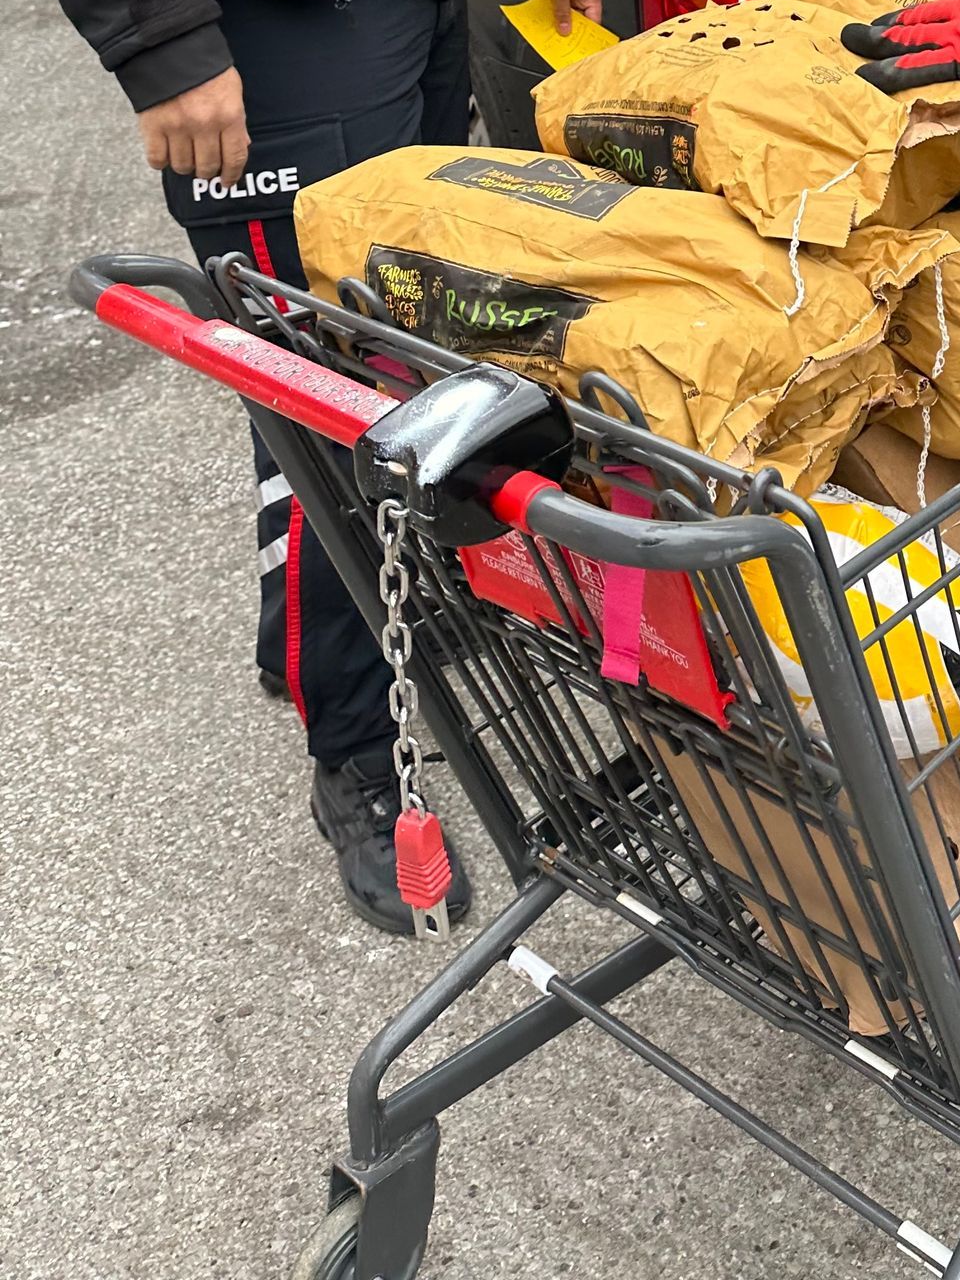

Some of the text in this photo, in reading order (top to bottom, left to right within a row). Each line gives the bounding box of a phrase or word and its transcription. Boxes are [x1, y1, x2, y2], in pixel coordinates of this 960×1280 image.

[192, 166, 300, 202] POLICE
[378, 264, 421, 284] FARMER'S
[481, 555, 508, 575] PLEASE
[506, 567, 539, 588] RETURN
[641, 635, 690, 669] THANK YOU
